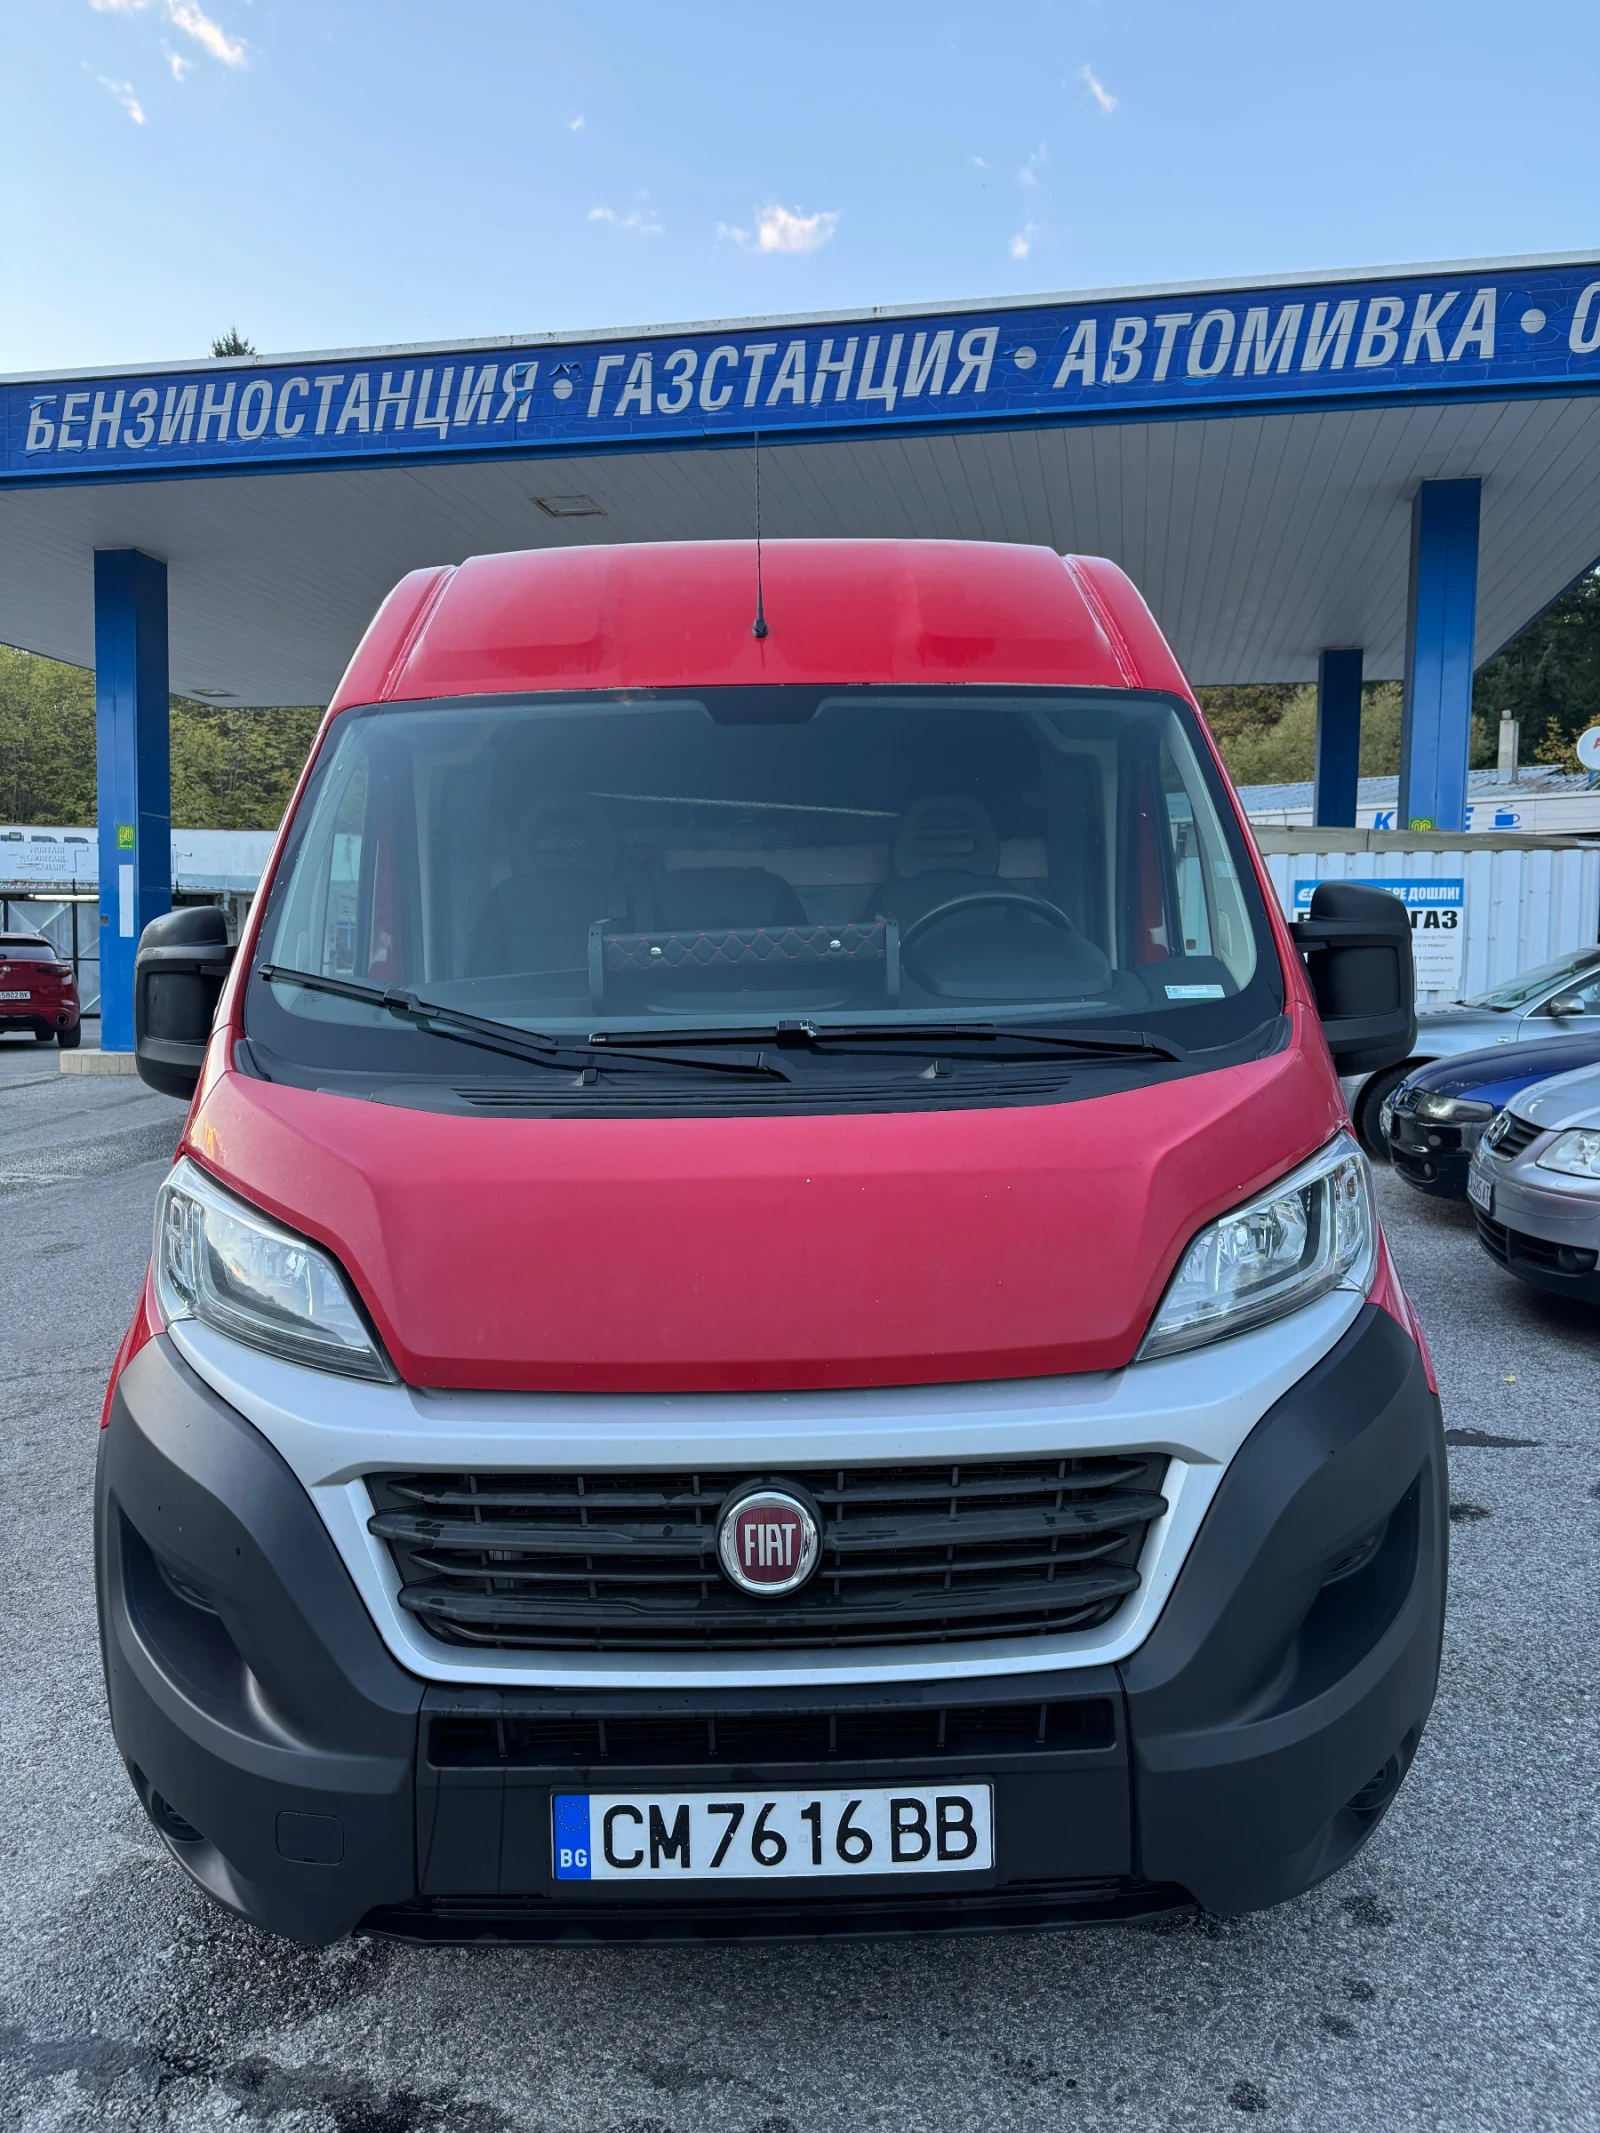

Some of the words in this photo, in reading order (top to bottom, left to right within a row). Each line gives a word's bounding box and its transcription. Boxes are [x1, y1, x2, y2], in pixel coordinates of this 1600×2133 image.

[25, 361, 539, 450] БЕНЗИНОСТАНЦИЯ
[587, 327, 1000, 417] ГАЗСТАНЦИЯ
[1052, 287, 1497, 388] АВТОМИВКА
[1408, 887, 1460, 902] ДОШЛИ!
[744, 1523, 797, 1567] FIAT
[560, 1848, 588, 1868] BG
